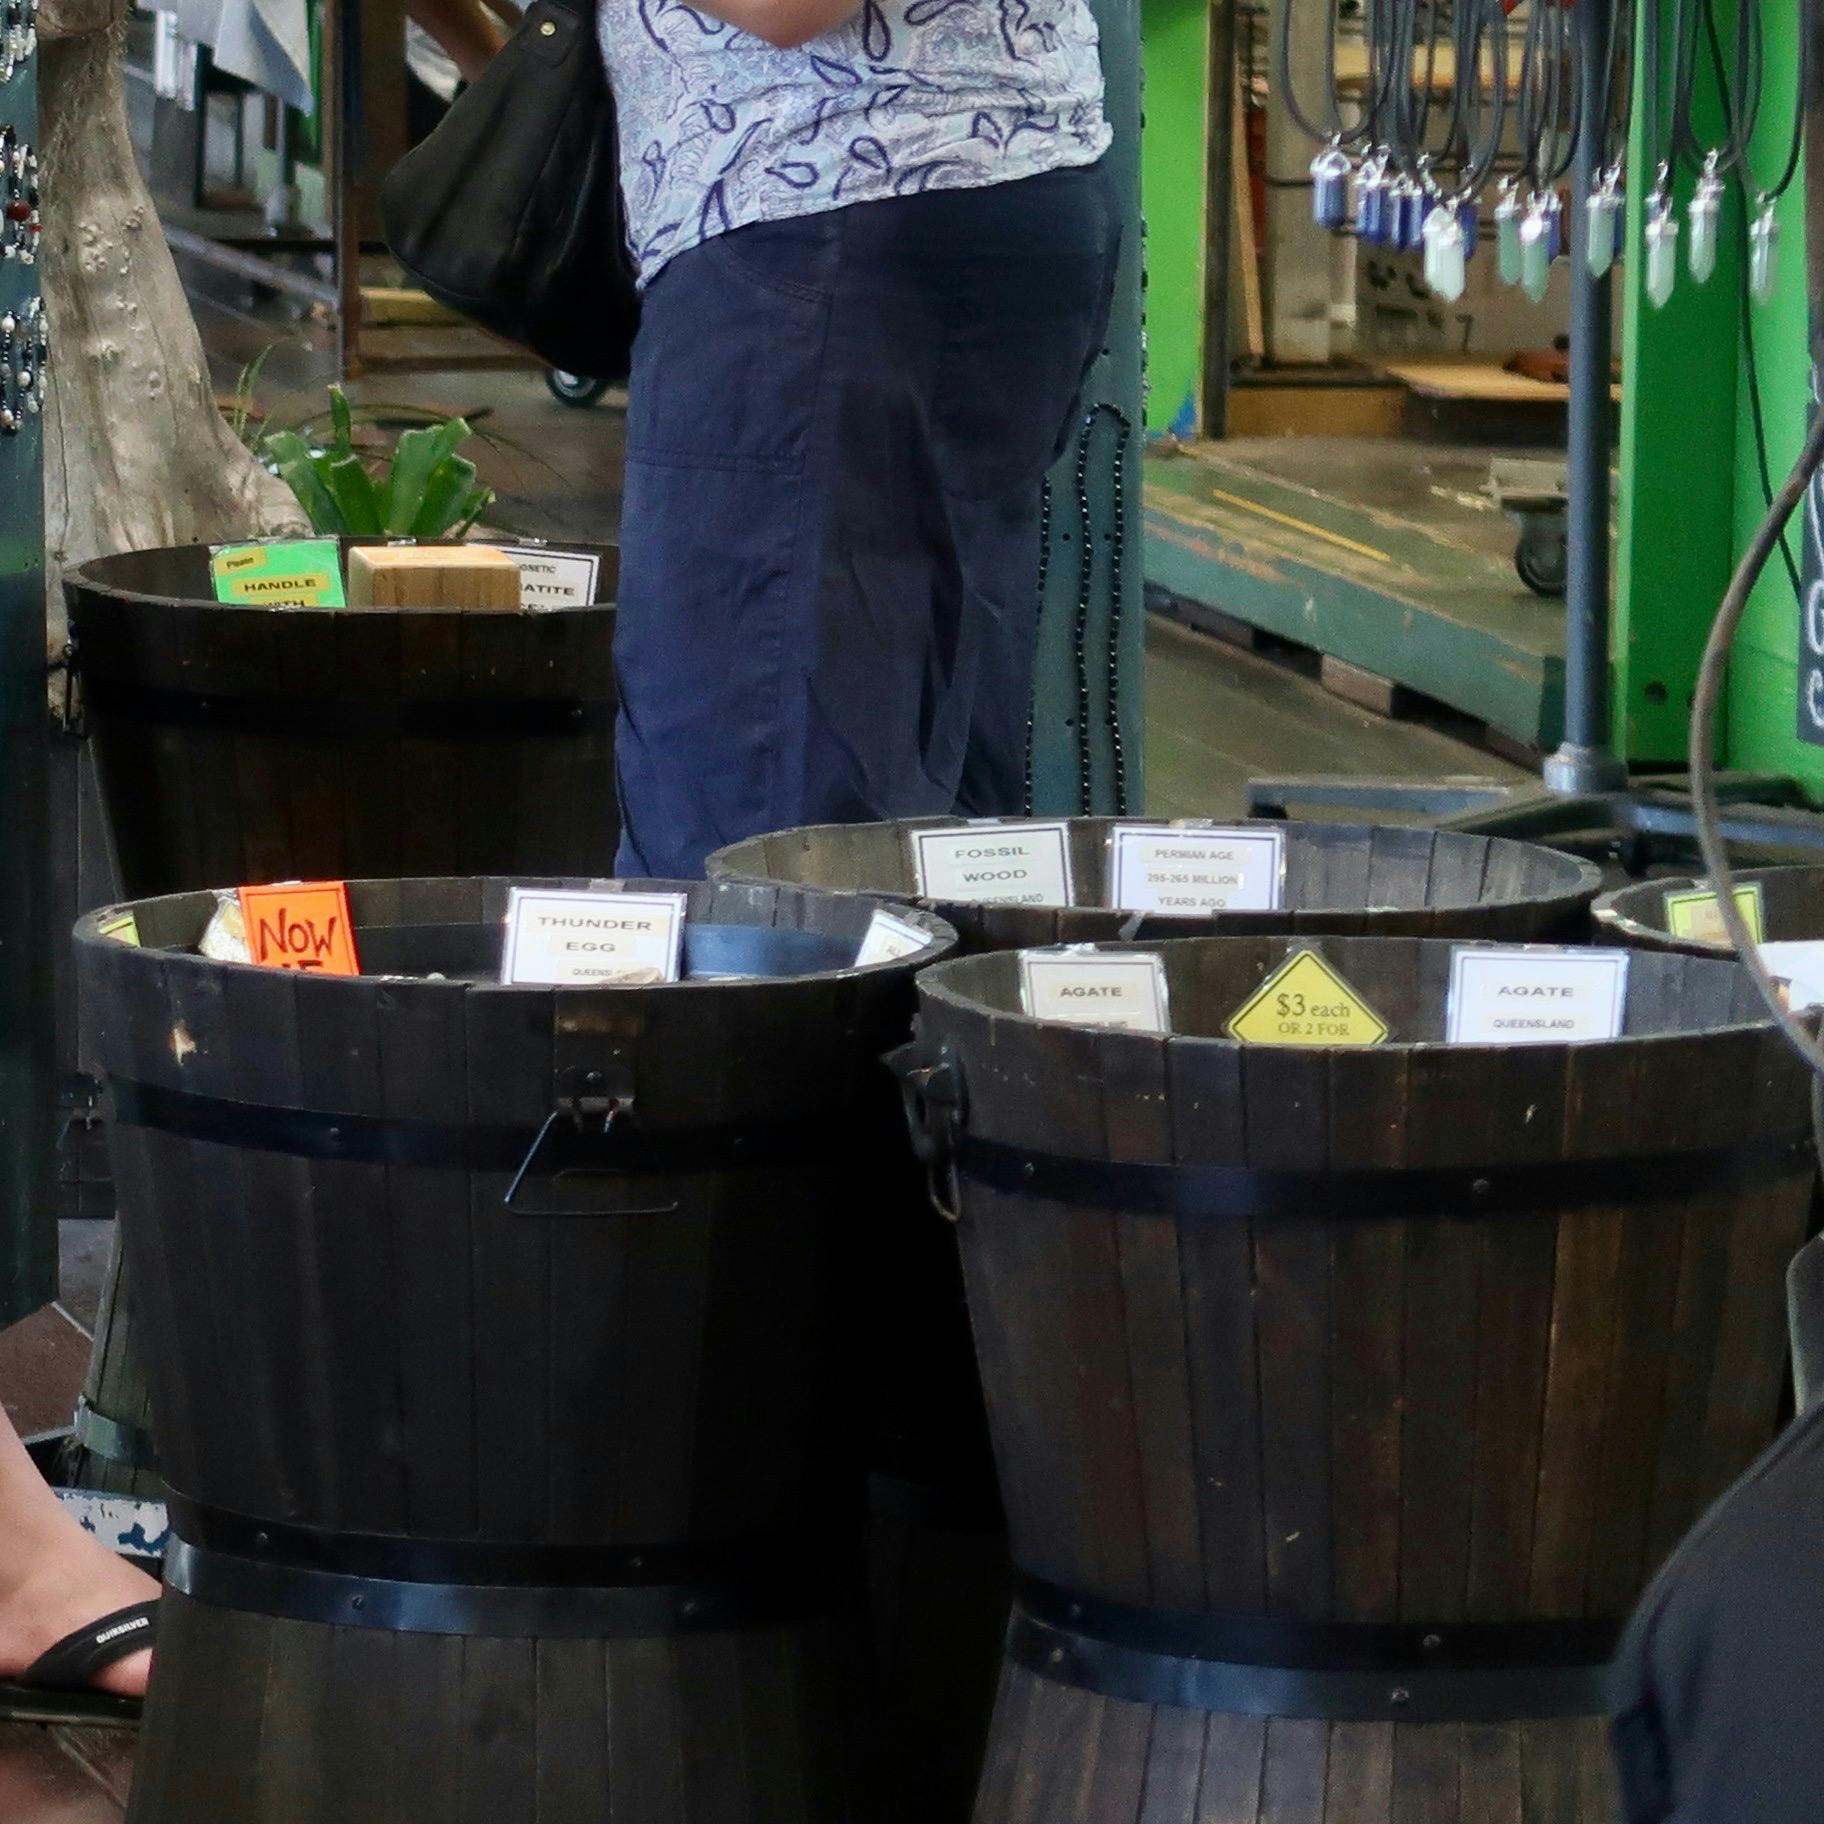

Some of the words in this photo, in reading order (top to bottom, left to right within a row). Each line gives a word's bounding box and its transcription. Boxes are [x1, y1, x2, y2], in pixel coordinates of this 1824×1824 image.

[244, 579, 317, 592] HANDLE
[954, 846, 1031, 859] FOSSIL
[1154, 848, 1206, 860] PERMIAN
[1209, 850, 1235, 861] AGE
[963, 869, 1029, 883] WOOD
[1193, 874, 1239, 886] MILLION
[1158, 895, 1198, 907] YEARS
[1199, 897, 1227, 909] AGO
[538, 916, 653, 932] THUNDER
[565, 941, 617, 953] EGG
[1059, 986, 1123, 998] AGATE
[1497, 985, 1575, 997] AGATE
[1276, 992, 1306, 1018] $3
[1309, 1000, 1351, 1018] each
[1278, 1021, 1302, 1035] OR
[1305, 1022, 1313, 1035] 2
[1317, 1022, 1351, 1036] FOR
[1492, 1018, 1576, 1029] QUEENSLAND
